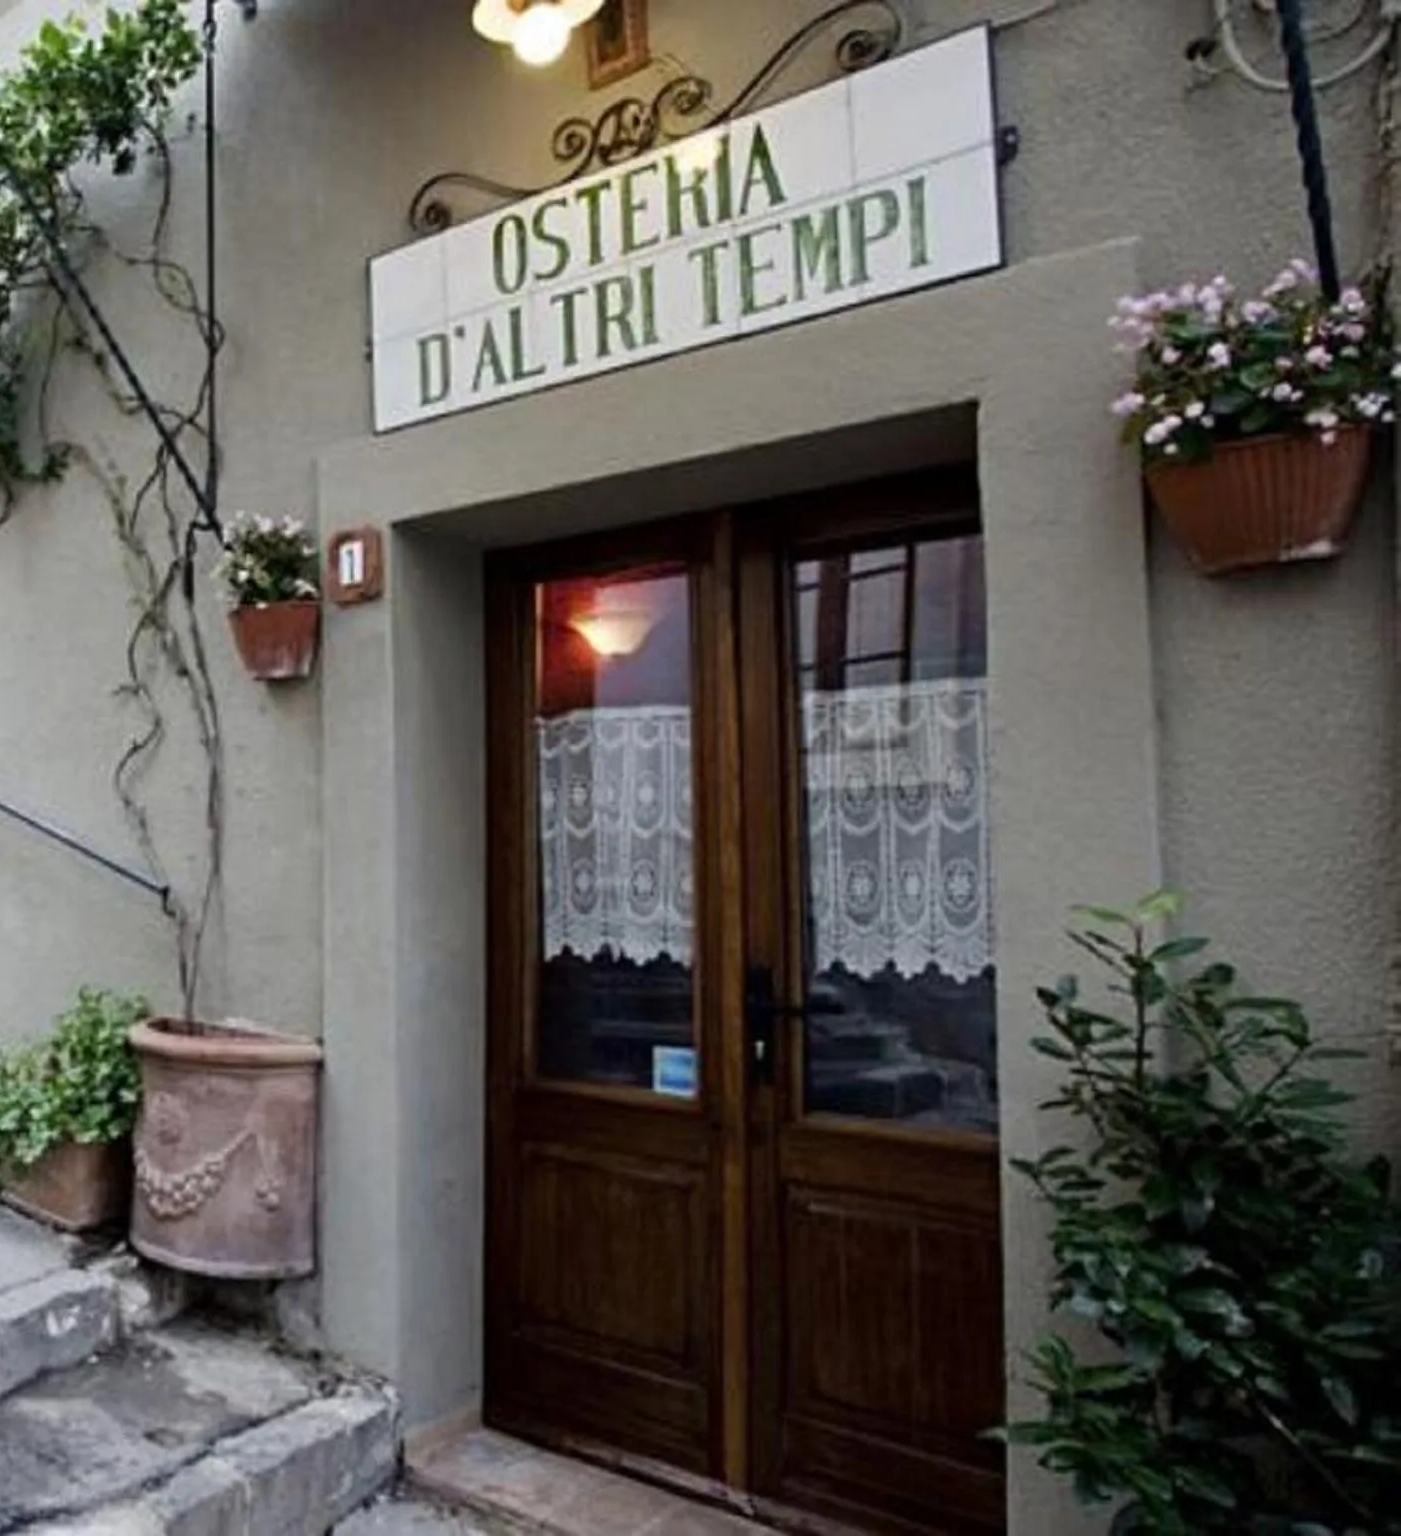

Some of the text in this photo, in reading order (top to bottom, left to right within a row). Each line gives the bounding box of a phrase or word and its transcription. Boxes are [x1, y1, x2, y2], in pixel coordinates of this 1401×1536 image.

[418, 176, 932, 406] D'ALTRI TEMPI
[494, 122, 787, 295] OSTERIA
